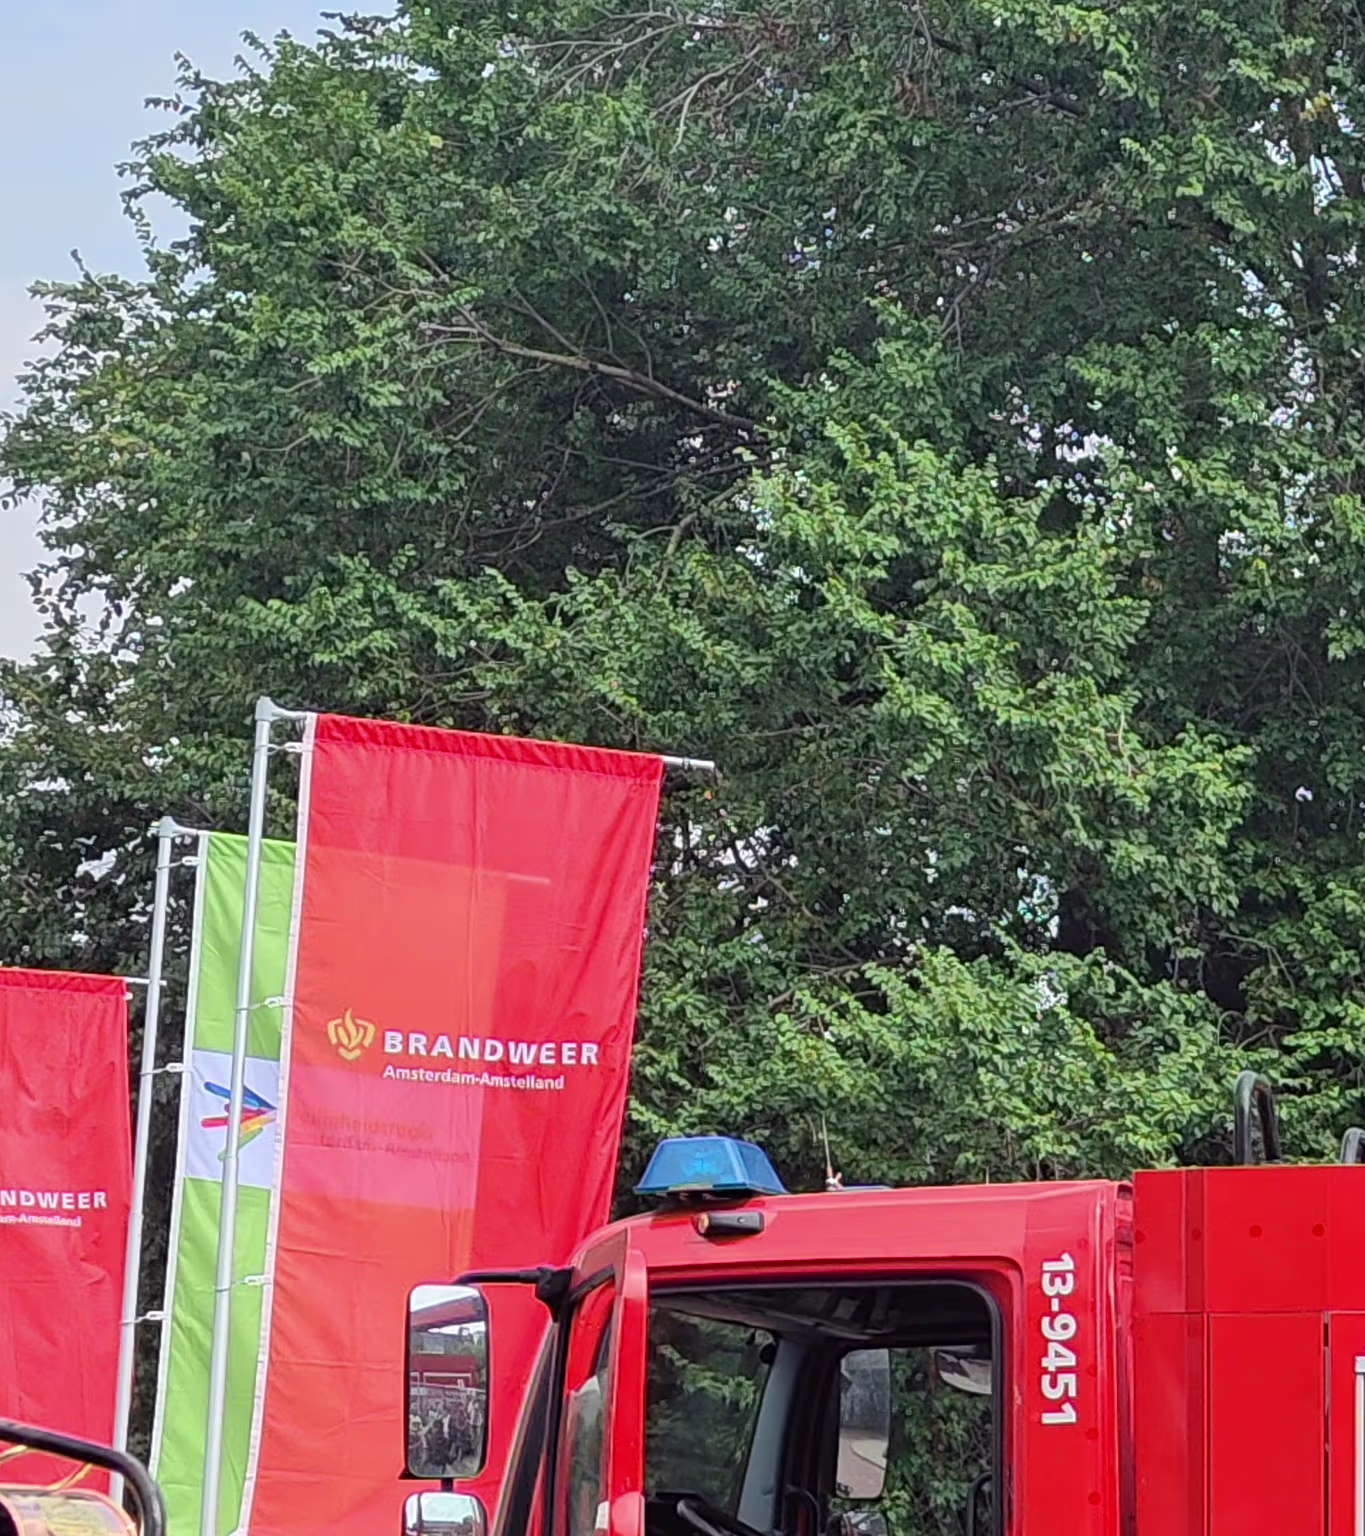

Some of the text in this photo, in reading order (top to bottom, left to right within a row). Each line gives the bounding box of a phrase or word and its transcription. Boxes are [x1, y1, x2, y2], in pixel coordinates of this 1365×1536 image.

[383, 1030, 599, 1065] BRANDWEER
[383, 1065, 565, 1091] Amsterdam-Amstelland
[1041, 1252, 1077, 1425] 13-9451
